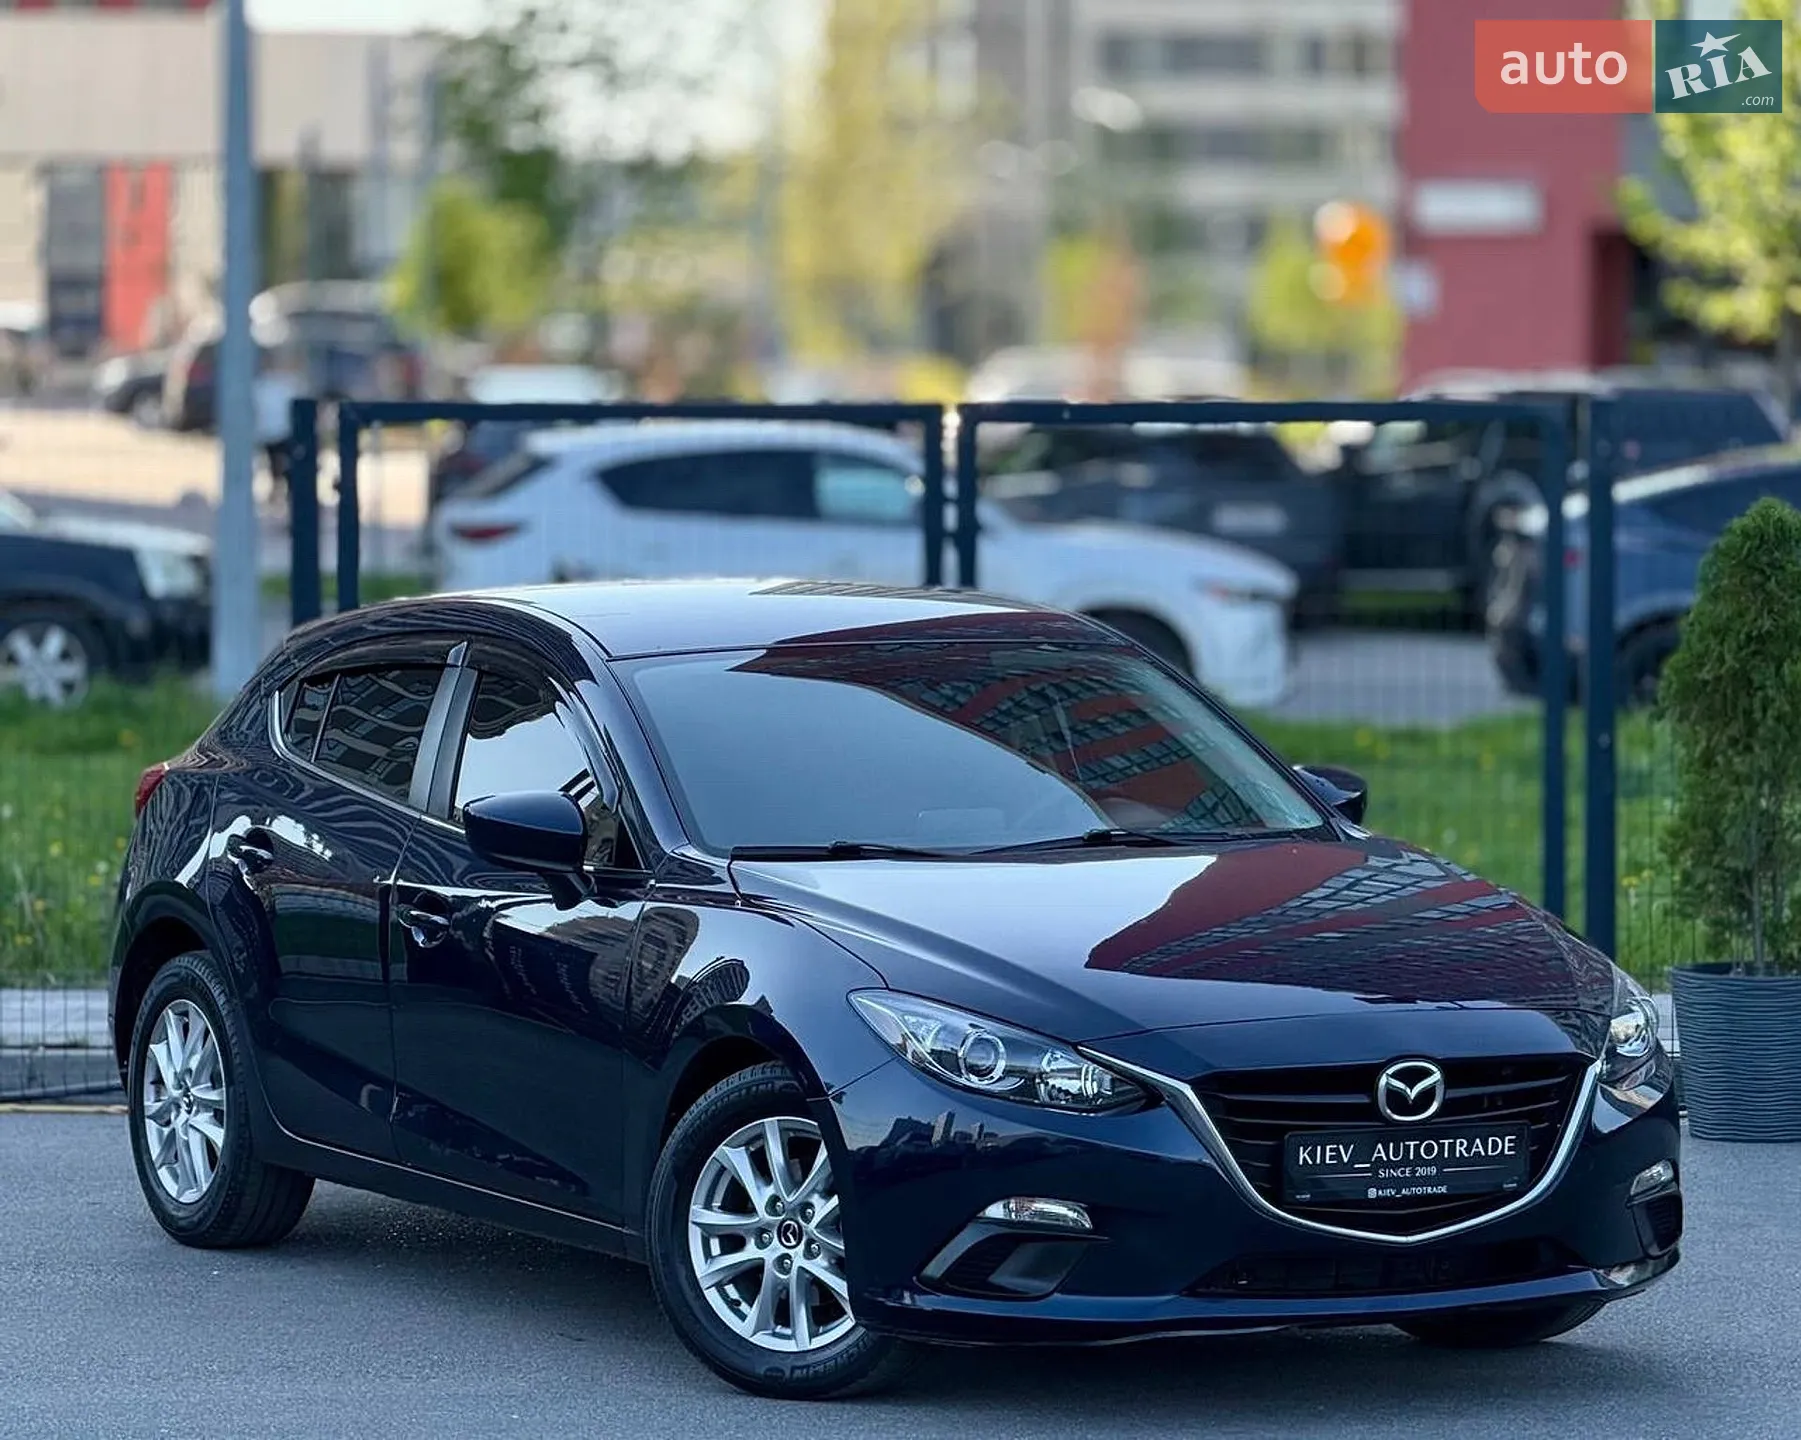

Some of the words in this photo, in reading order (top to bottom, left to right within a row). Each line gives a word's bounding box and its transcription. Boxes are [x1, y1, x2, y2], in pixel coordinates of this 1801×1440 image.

[1298, 1135, 1516, 1168] KIEV_AUTOTRADE
[1378, 1167, 1411, 1179] SINCE
[1415, 1165, 1437, 1177] 2019
